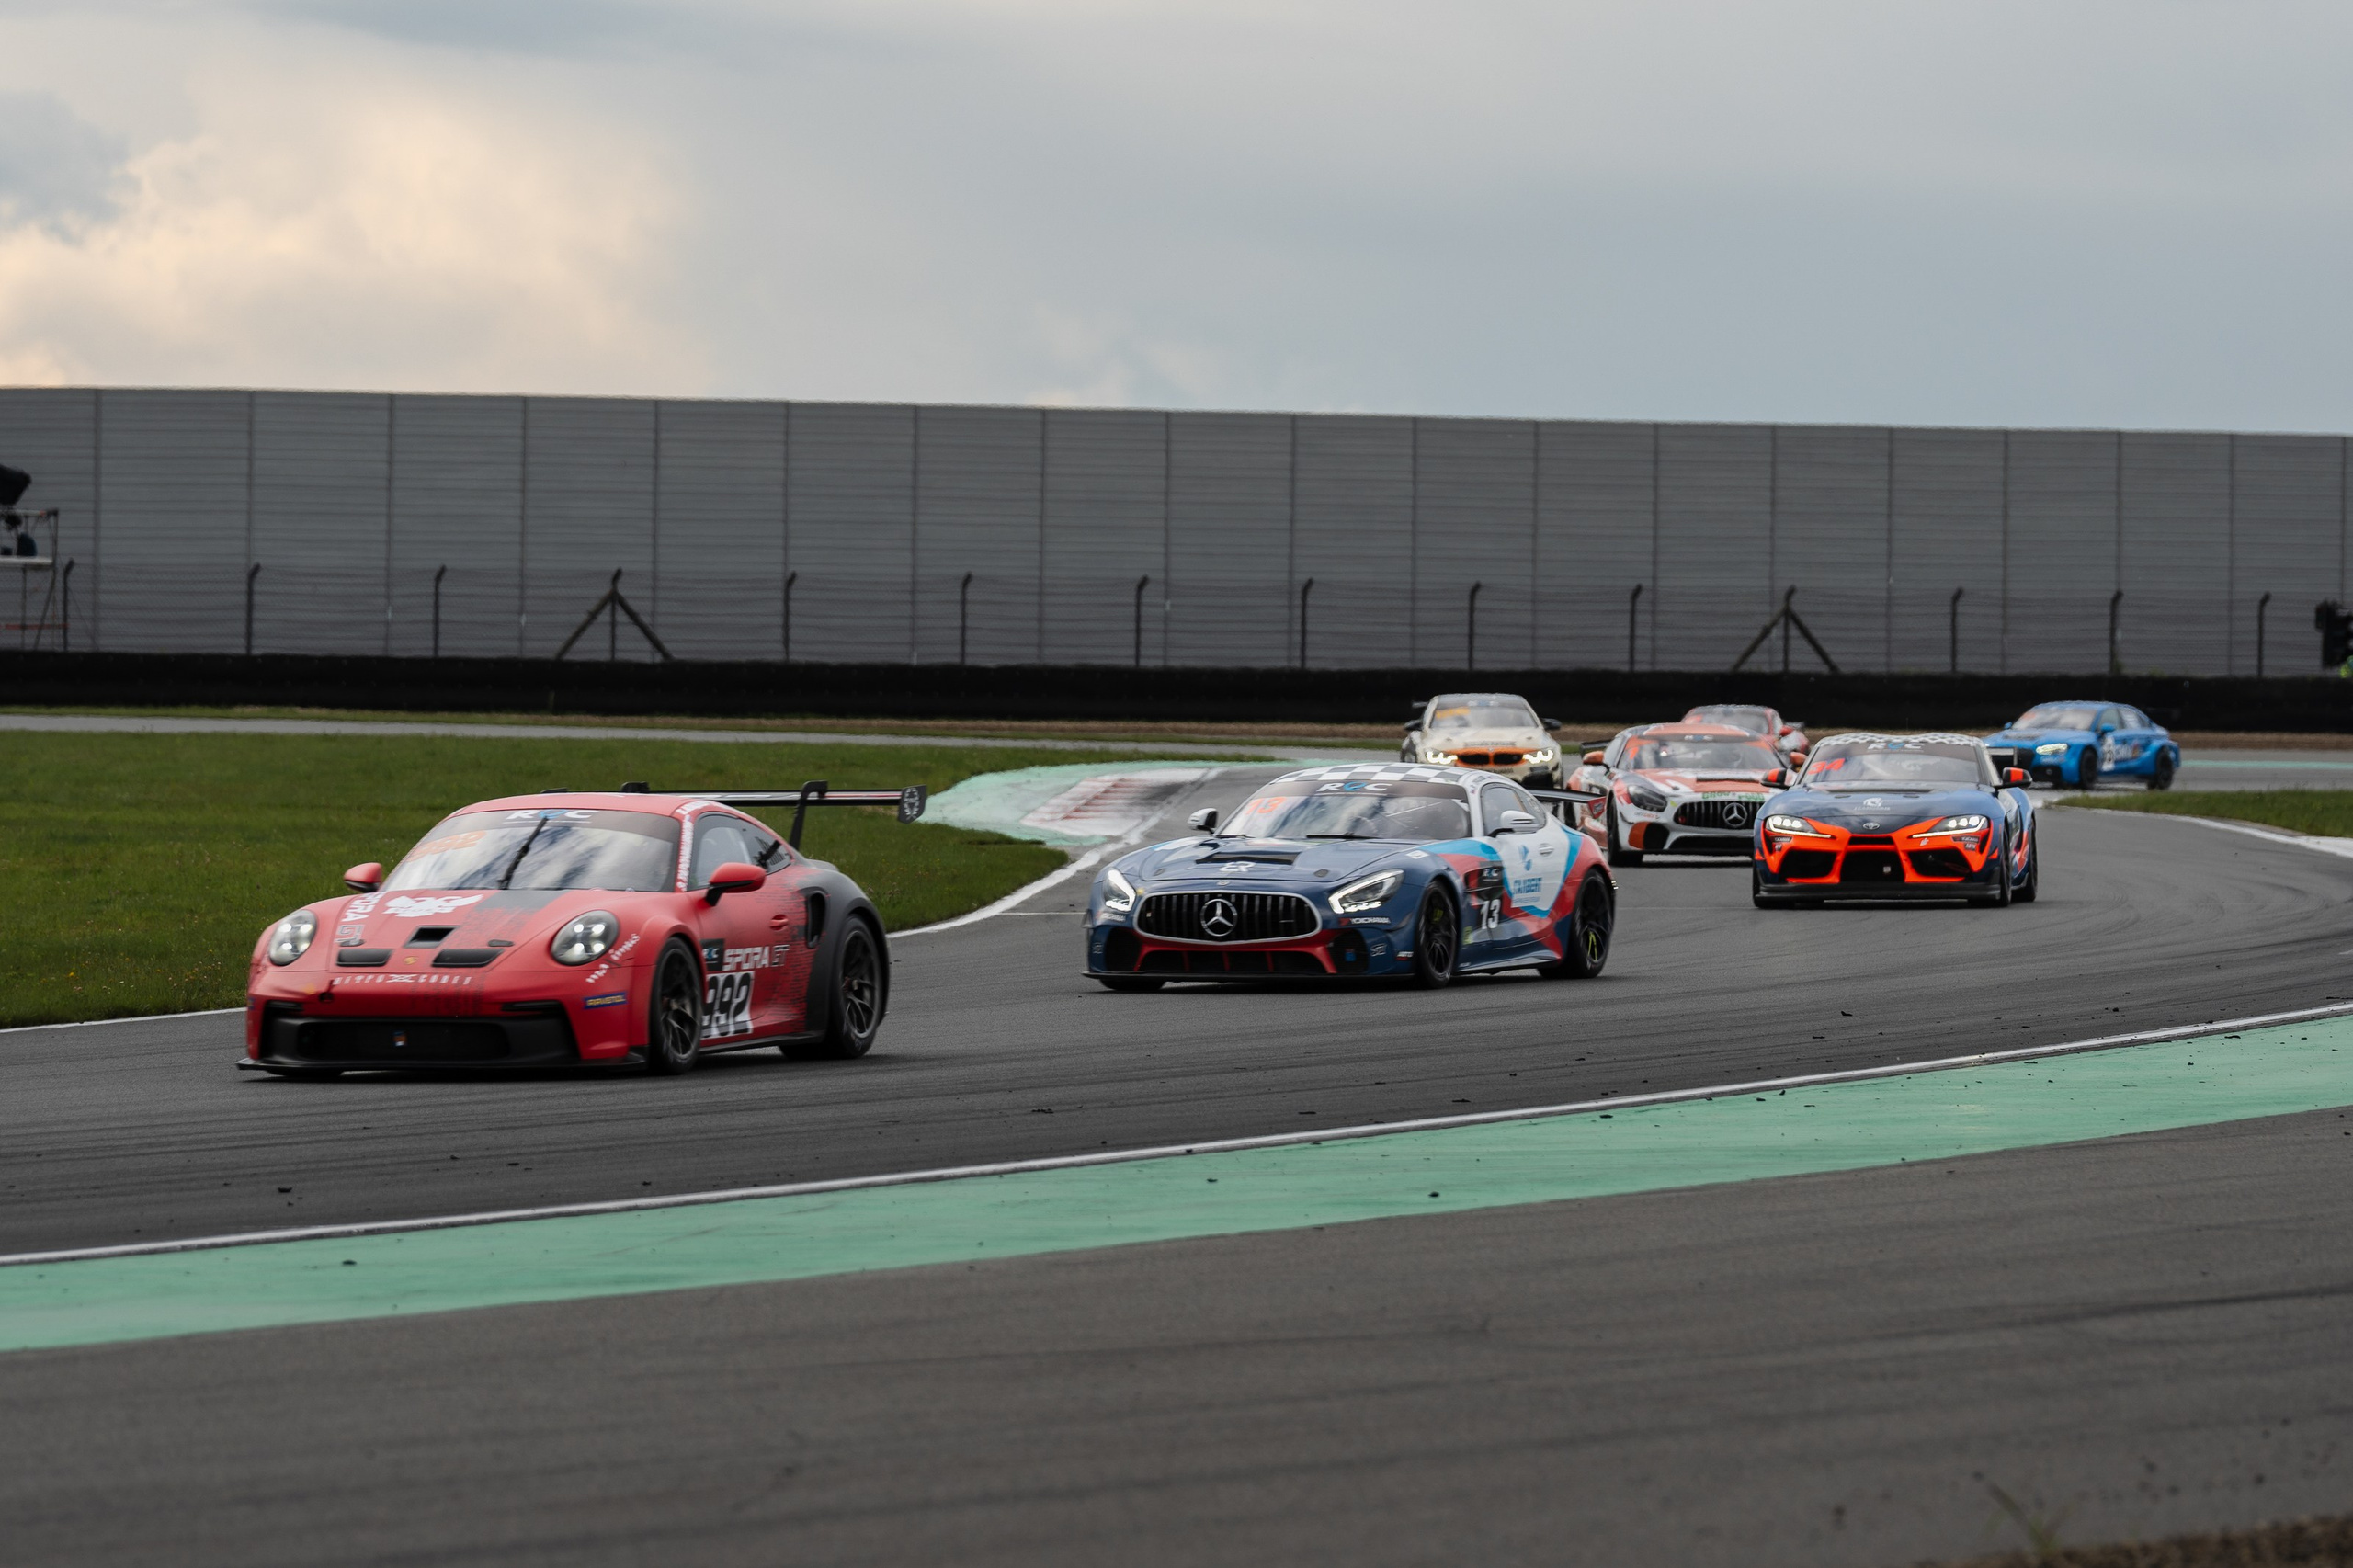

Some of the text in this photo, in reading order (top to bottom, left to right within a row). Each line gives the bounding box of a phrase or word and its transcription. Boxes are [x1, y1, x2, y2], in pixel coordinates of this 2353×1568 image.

[1807, 758, 1846, 775] 34
[1245, 797, 1287, 815] 13
[1480, 899, 1501, 929] 13
[722, 946, 770, 971] SPORA
